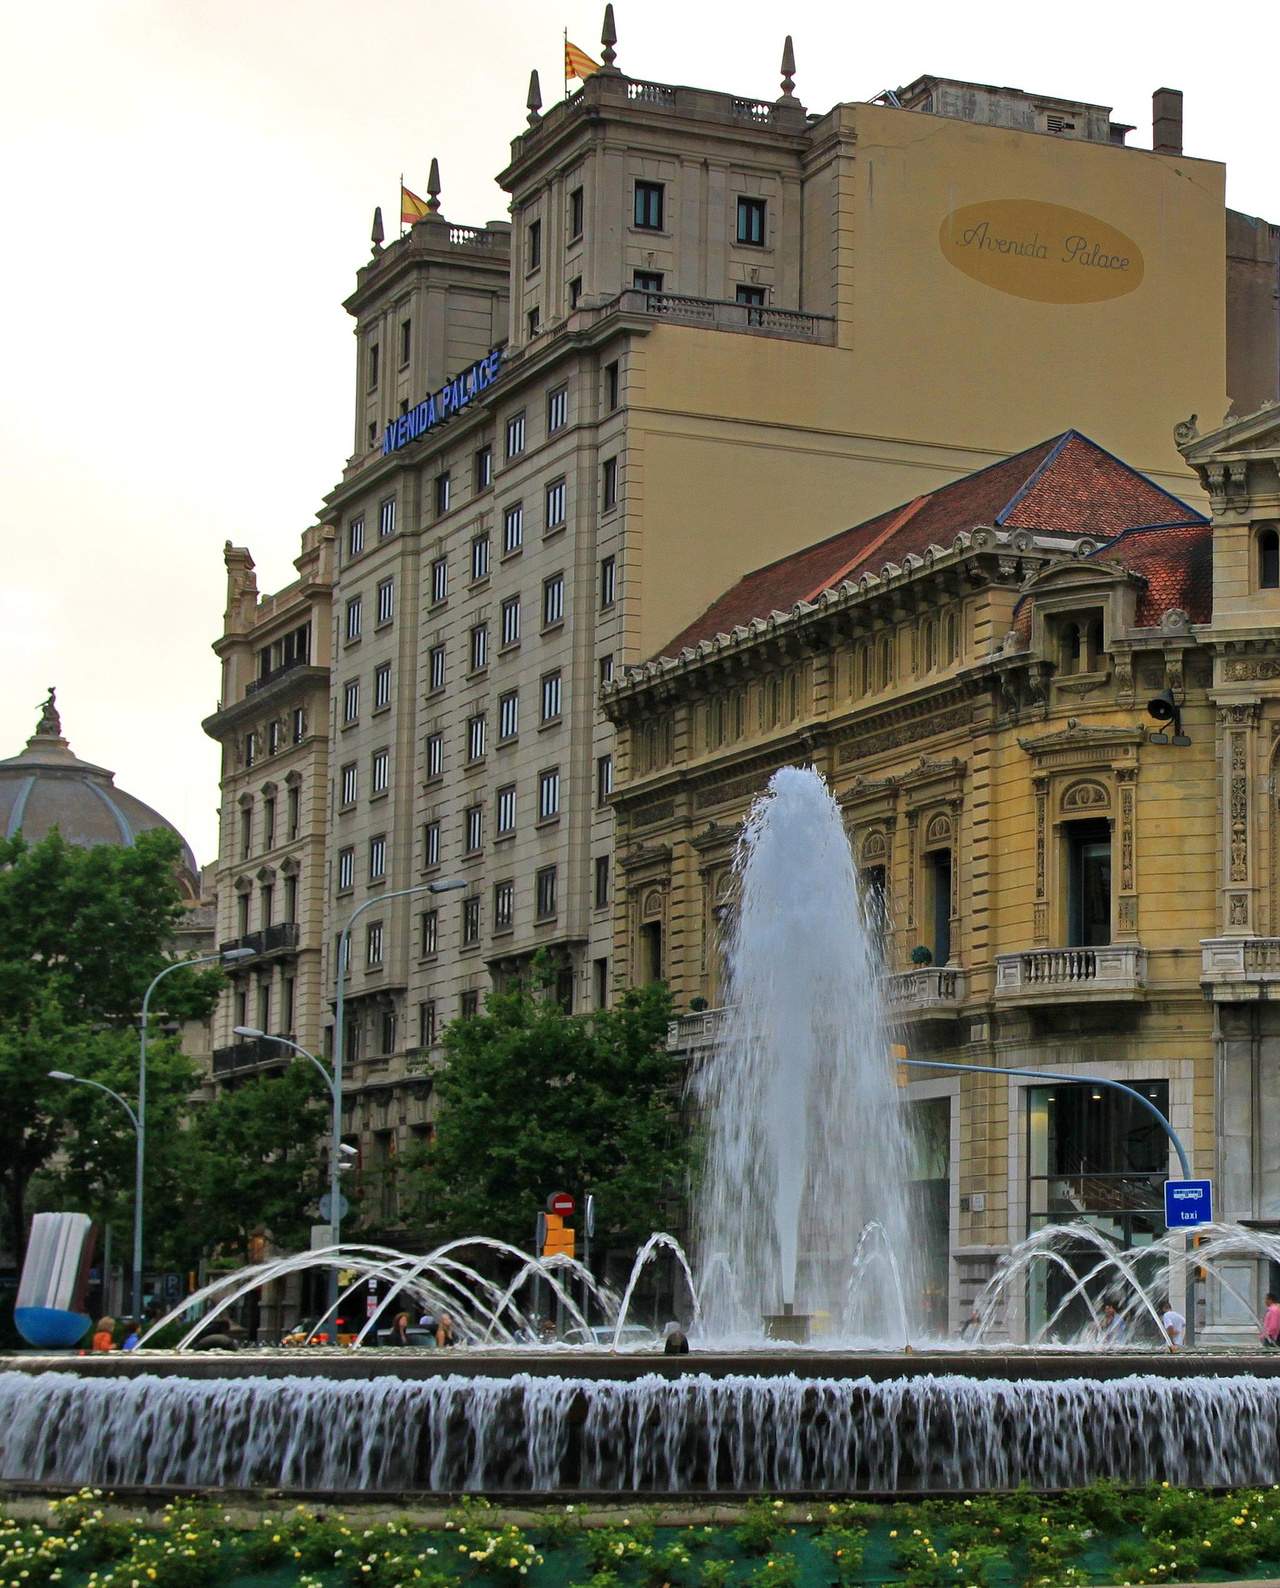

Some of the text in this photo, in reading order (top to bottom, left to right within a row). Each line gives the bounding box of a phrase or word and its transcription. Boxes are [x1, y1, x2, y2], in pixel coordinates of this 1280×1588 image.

[956, 221, 1130, 272] Avenida Palace
[381, 351, 501, 457] AVENIDA PALACE
[1180, 1210, 1198, 1220] taxi
